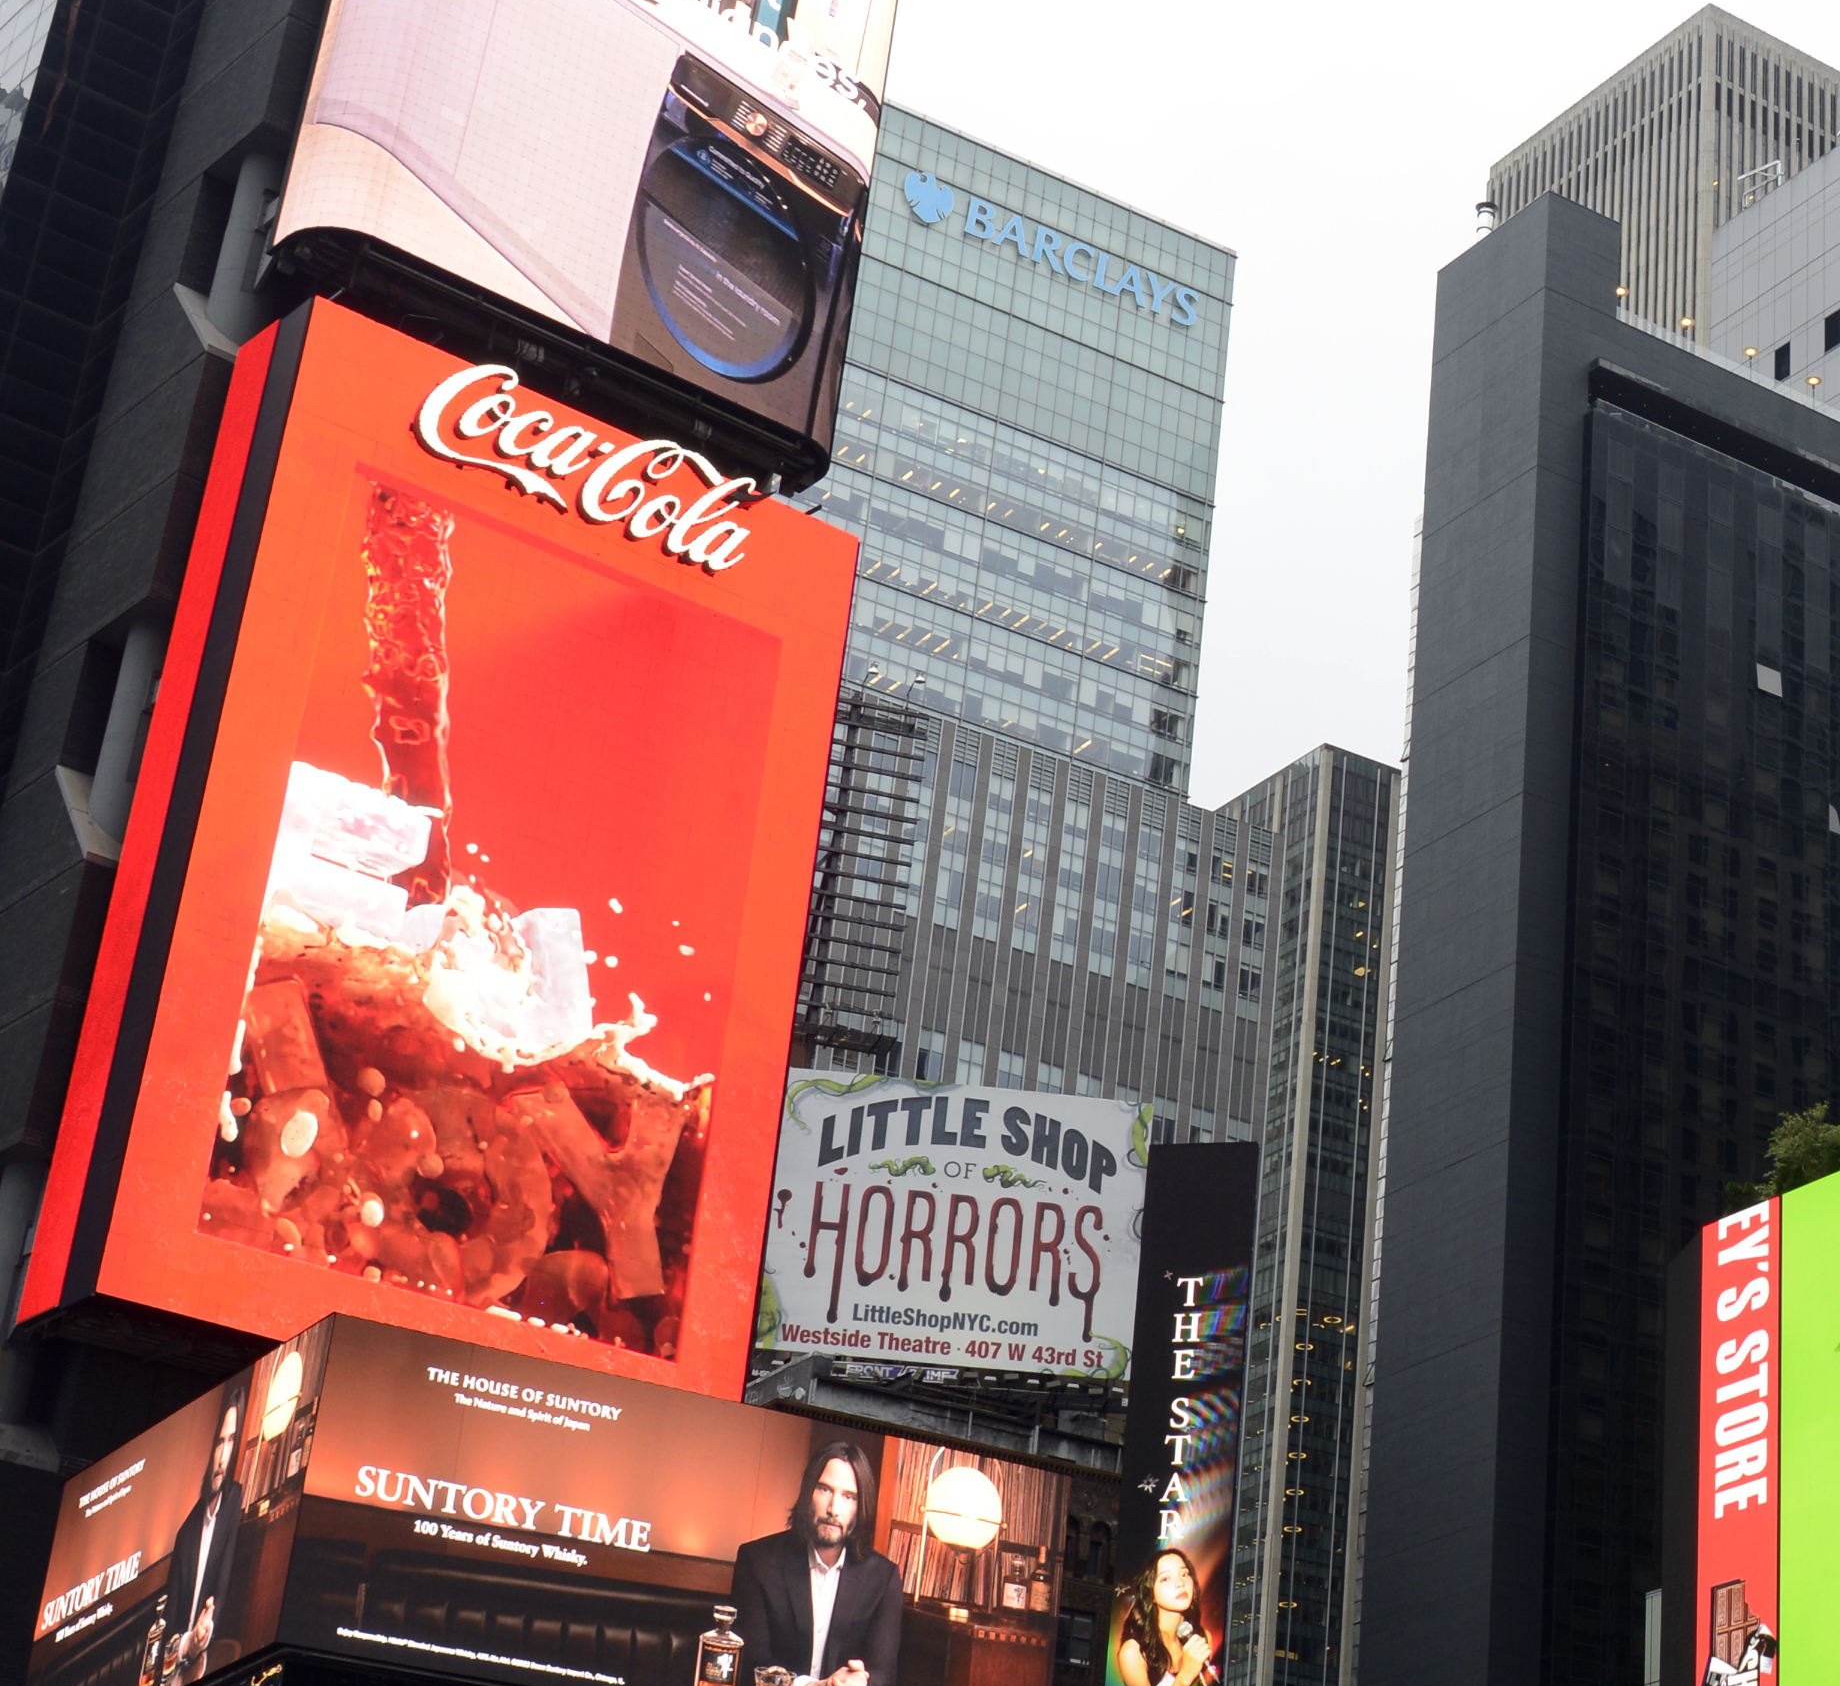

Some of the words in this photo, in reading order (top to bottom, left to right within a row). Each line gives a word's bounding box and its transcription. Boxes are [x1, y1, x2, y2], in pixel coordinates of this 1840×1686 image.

[962, 196, 1201, 328] BARCLAYS
[414, 363, 757, 574] Coca-Cola
[817, 1096, 991, 1168] LITTLE
[999, 1105, 1119, 1195] SHOP
[943, 1160, 978, 1181] OF
[802, 1180, 1105, 1344] HORRORS
[781, 1322, 872, 1350] Westside
[876, 1330, 952, 1358] Theatre
[965, 1339, 1002, 1360] 407
[1006, 1343, 1028, 1362] W
[1032, 1343, 1078, 1367] 43rd
[1082, 1349, 1104, 1368] St
[852, 1302, 1040, 1339] LittleShopNYC.com
[1171, 1276, 1204, 1380] THE
[426, 1366, 460, 1388] THE
[462, 1374, 520, 1400] HOUSE
[521, 1386, 545, 1405] OF
[546, 1393, 623, 1421] SUNTORY
[1713, 1328, 1770, 1521] STORE
[355, 1464, 546, 1531] SUNTORY
[554, 1502, 652, 1553] TIME
[1156, 1397, 1191, 1541] STAR
[41, 1571, 106, 1631] SUNTORY
[104, 1550, 142, 1595] TIME
[413, 1519, 438, 1536] 100
[440, 1524, 474, 1544] Years
[475, 1531, 491, 1546] of
[490, 1534, 540, 1559] Suntory
[541, 1543, 588, 1568] Whisky.
